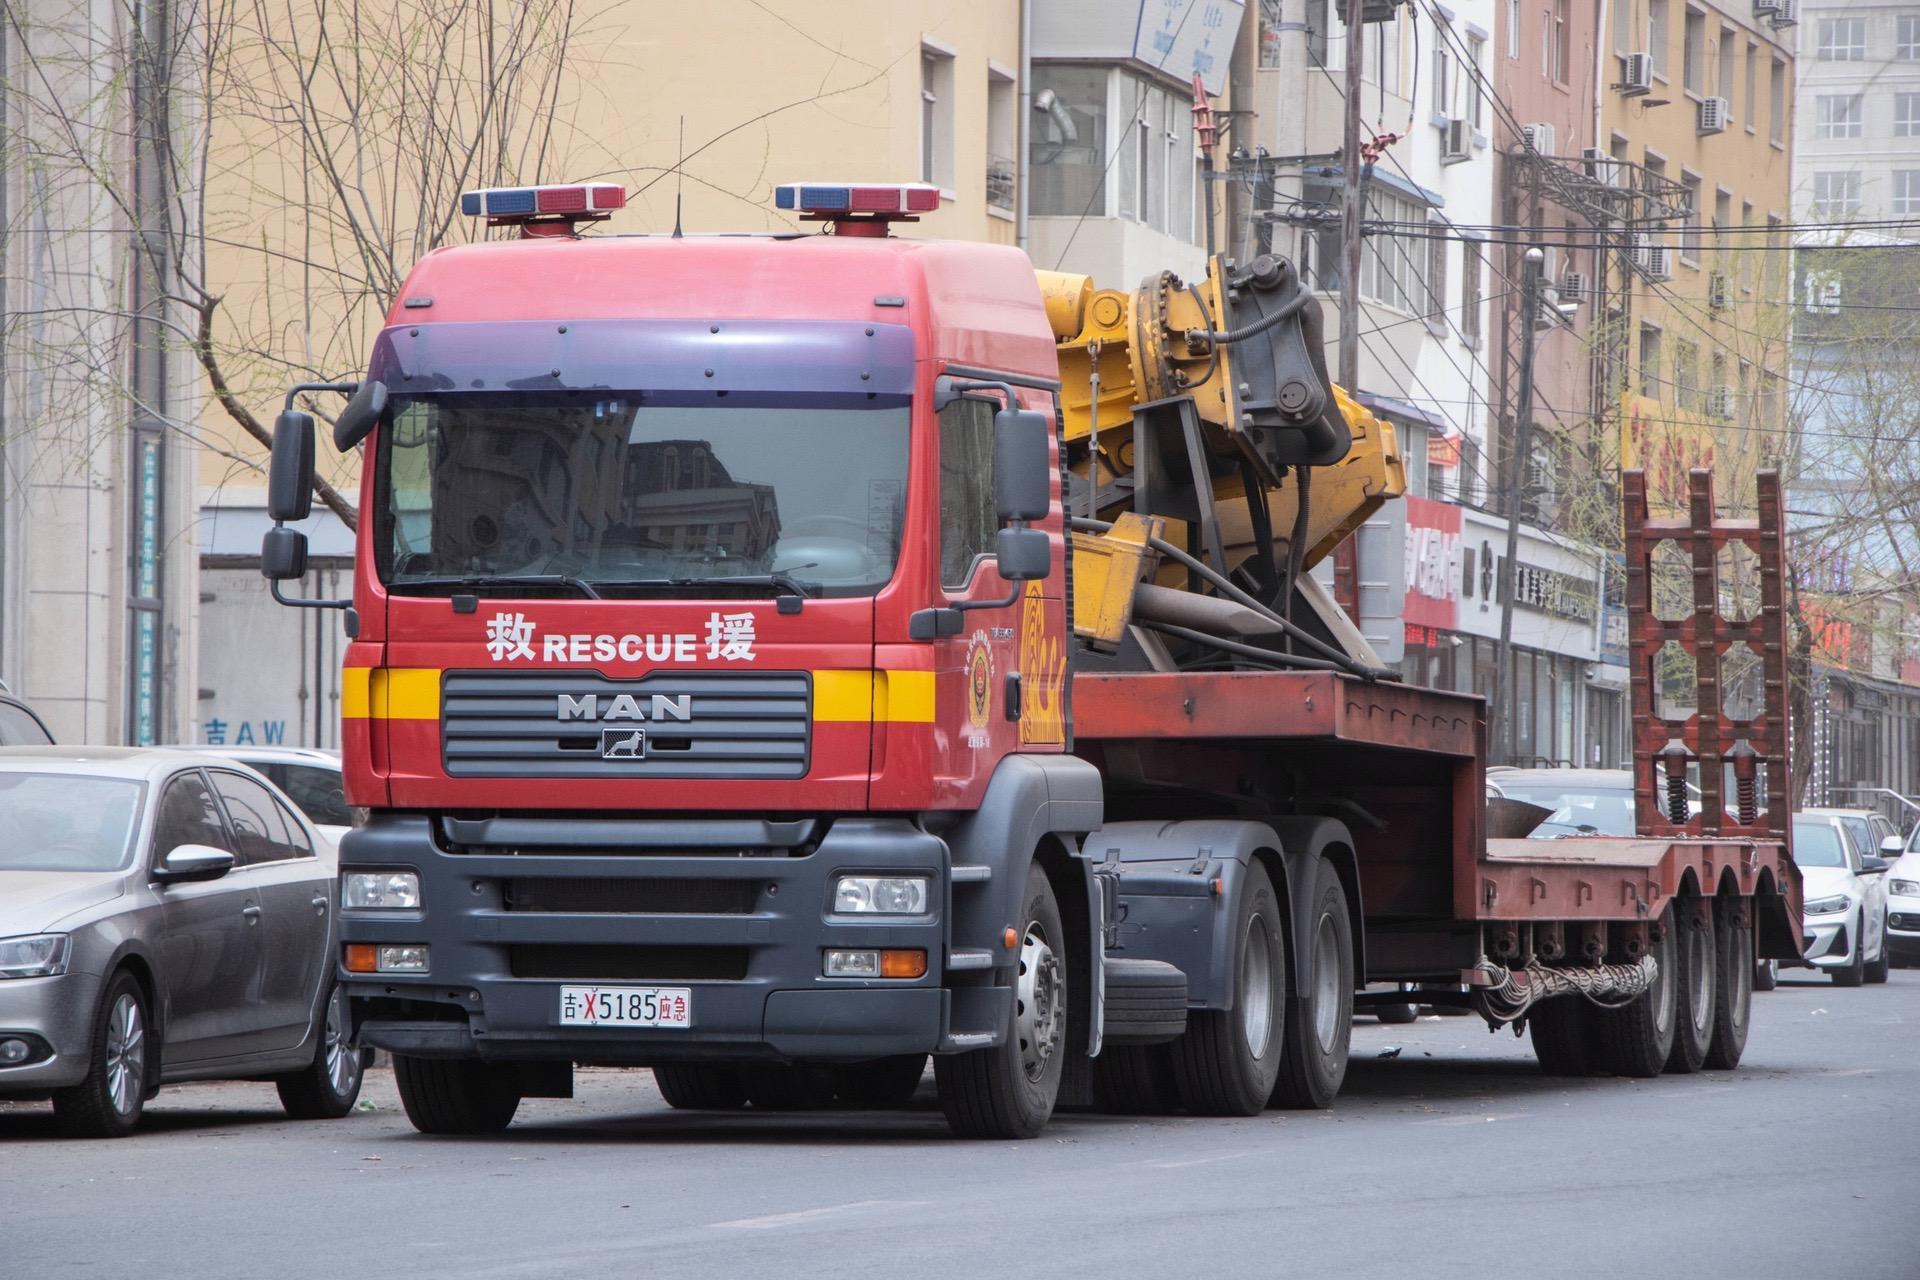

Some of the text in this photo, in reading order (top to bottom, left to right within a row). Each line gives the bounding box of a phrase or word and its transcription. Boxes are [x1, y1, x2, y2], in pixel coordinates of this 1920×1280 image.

[486, 612, 756, 662] 救 RESCUE 援
[557, 694, 691, 720] MAN
